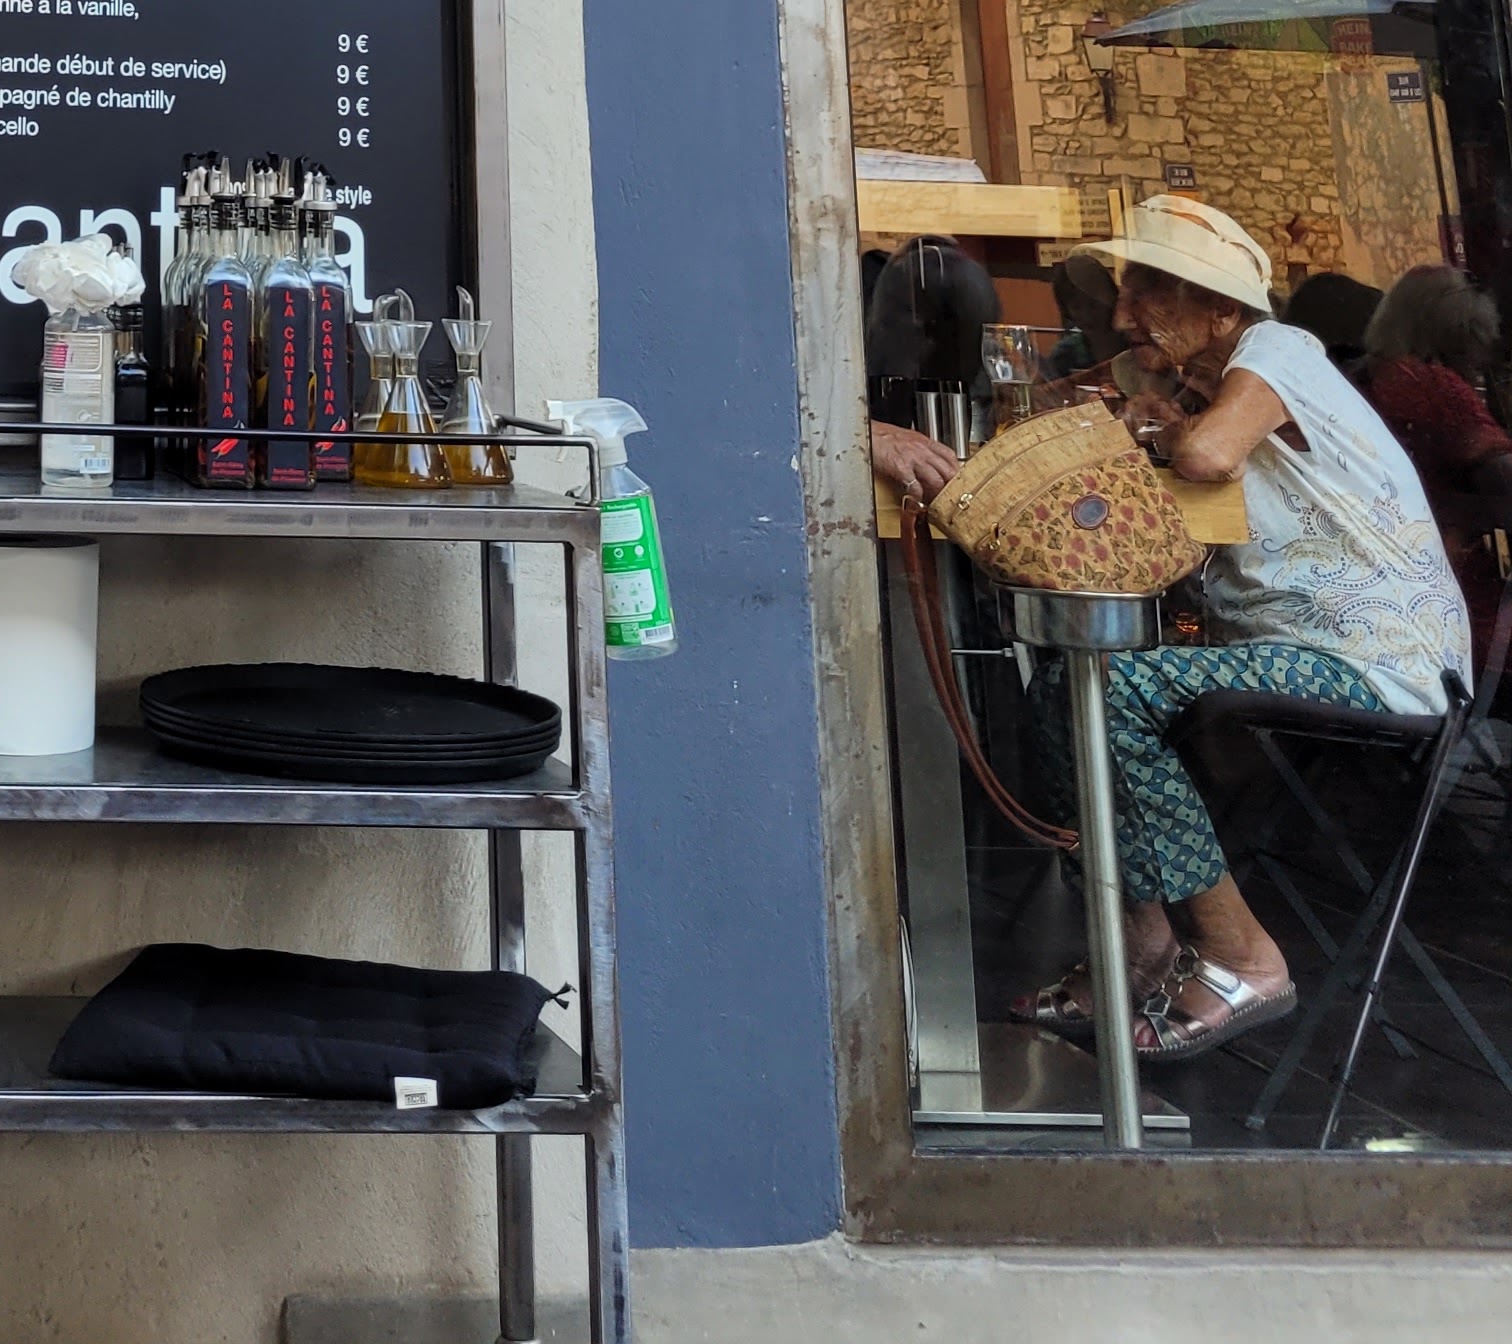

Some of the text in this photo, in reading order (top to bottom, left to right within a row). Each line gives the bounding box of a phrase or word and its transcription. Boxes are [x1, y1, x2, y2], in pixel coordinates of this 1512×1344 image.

[66, 87, 91, 107] de
[97, 88, 176, 114] chantilly
[337, 97, 350, 116] 9
[356, 97, 369, 117] €
[335, 185, 372, 209] style
[222, 283, 234, 419] LA CANTINA
[283, 290, 295, 426] LA CANTINA
[321, 286, 336, 415] LA CANTINA
